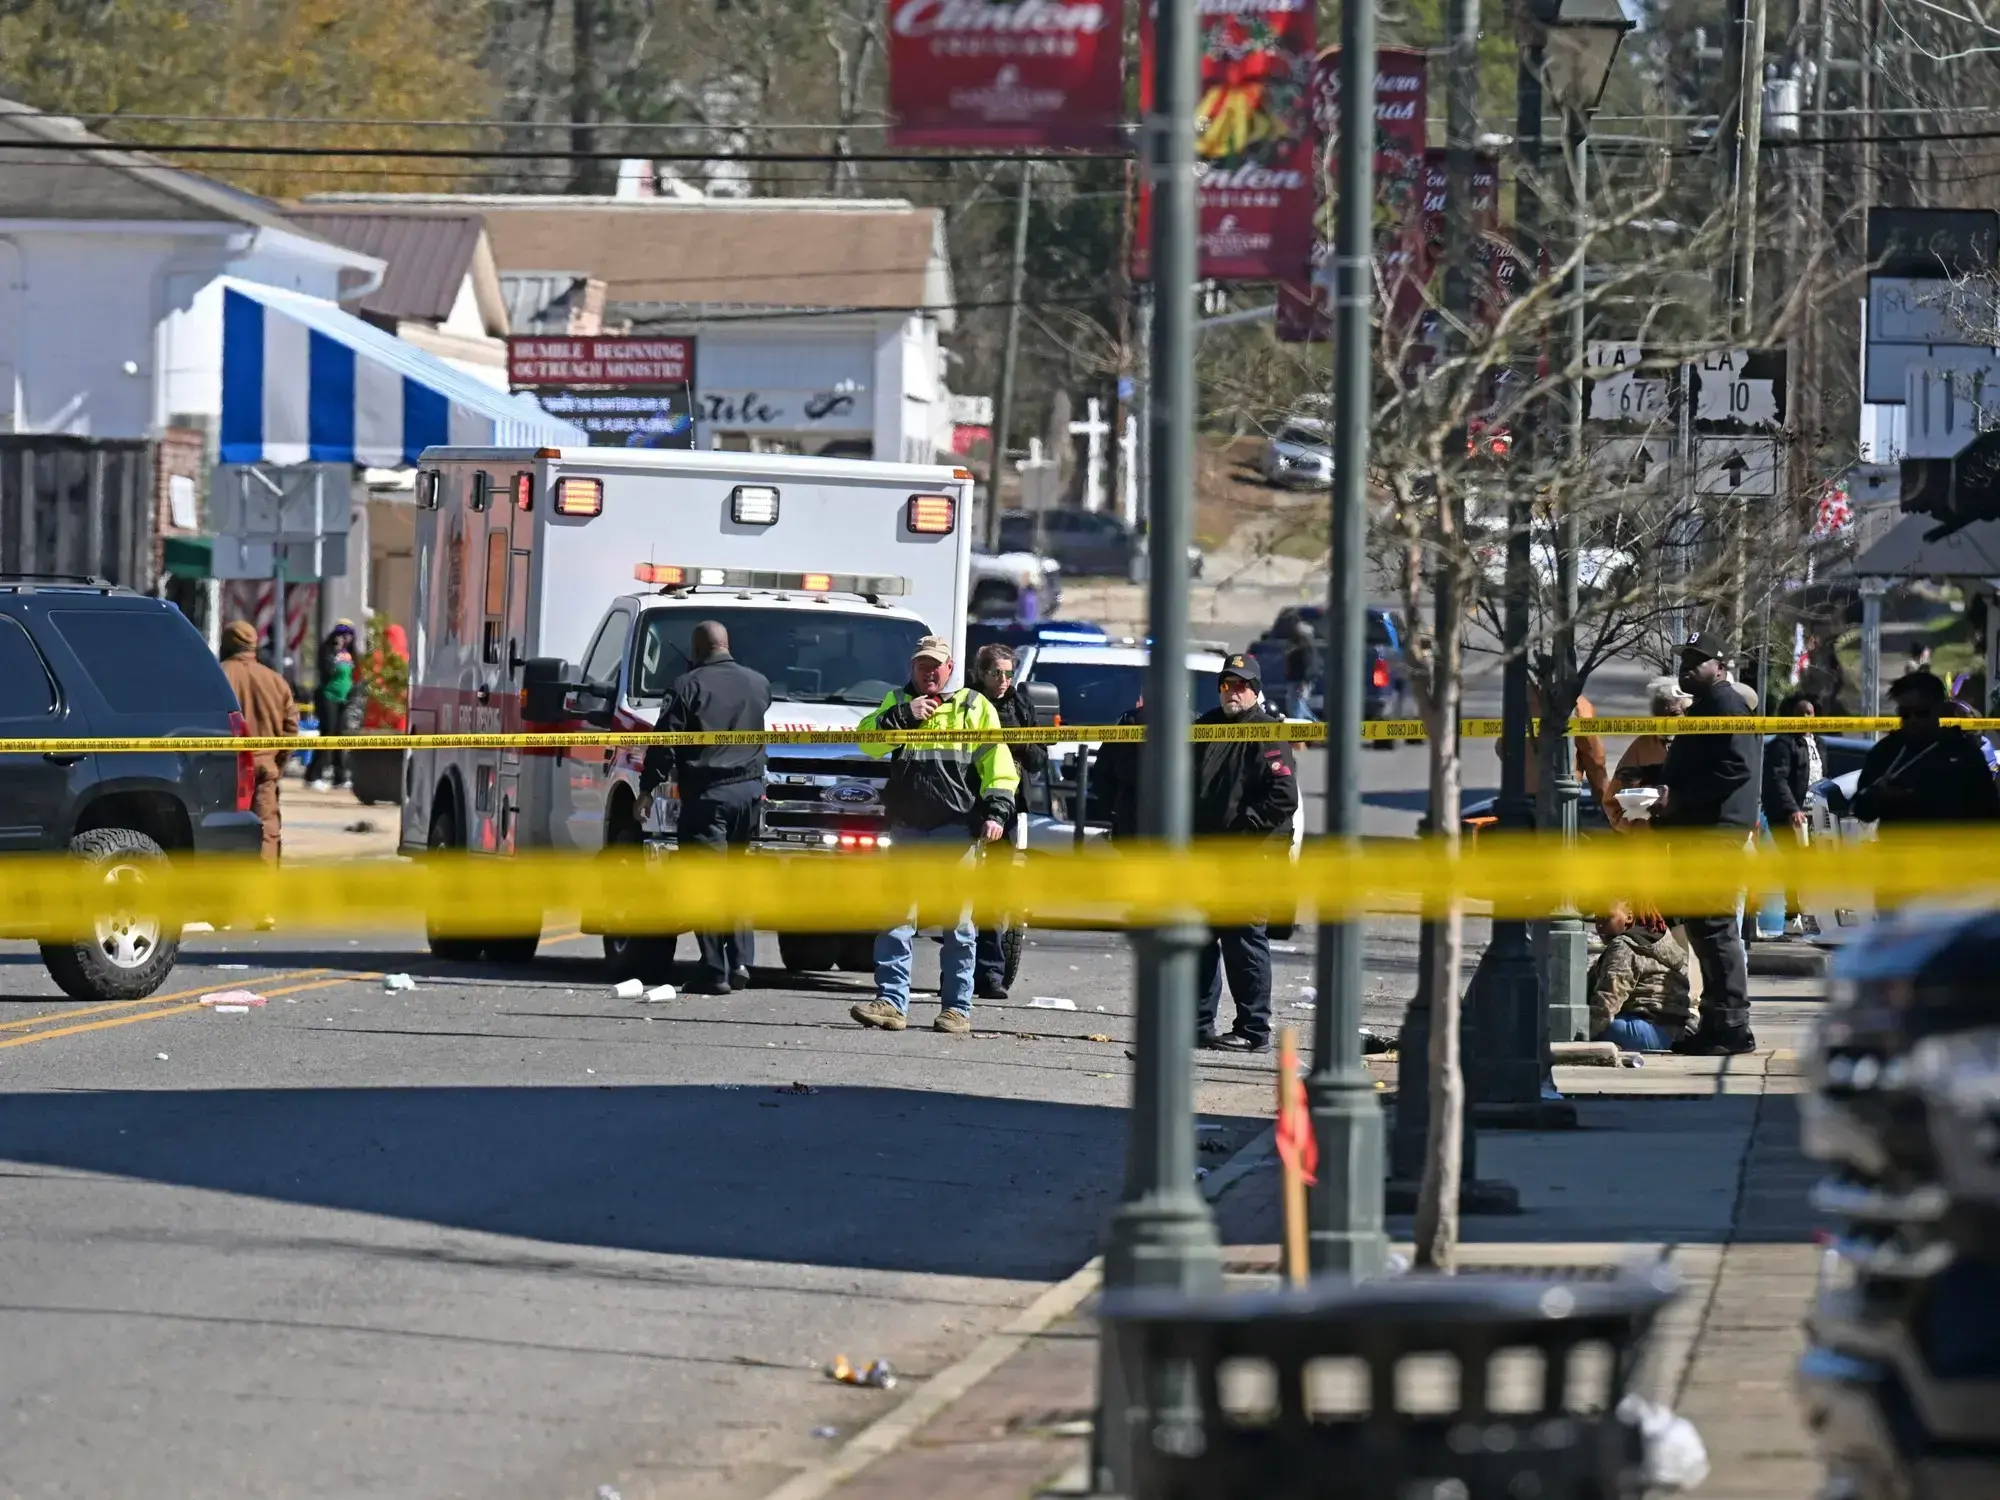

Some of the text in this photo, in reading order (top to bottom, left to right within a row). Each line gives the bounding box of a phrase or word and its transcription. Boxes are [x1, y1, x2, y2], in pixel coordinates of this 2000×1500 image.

[1728, 383, 1750, 412] 10
[1386, 724, 1406, 736] CROSS
[1407, 724, 1418, 736] NOT
[1580, 720, 1656, 732] POLICE LINE DO NOT CROSS
[1678, 720, 1755, 731] POLICE LINE DO NOT CROSS
[810, 733, 886, 743] POLICE LINE DO NOT CROSS
[1002, 730, 1077, 741] POLICE LINE DO NOT CROSS
[1098, 728, 1116, 740] CROSS
[1118, 728, 1129, 740] NOT
[1130, 728, 1138, 740] DO
[1194, 727, 1270, 739] POLICE LINE DO NOT CROSS
[1291, 726, 1309, 738] CROSS
[1311, 726, 1322, 738] NOT
[620, 735, 694, 744] POLICE LINE DO NOT CROSS
[715, 734, 789, 744] POLICE LINE DO NOT CROSS
